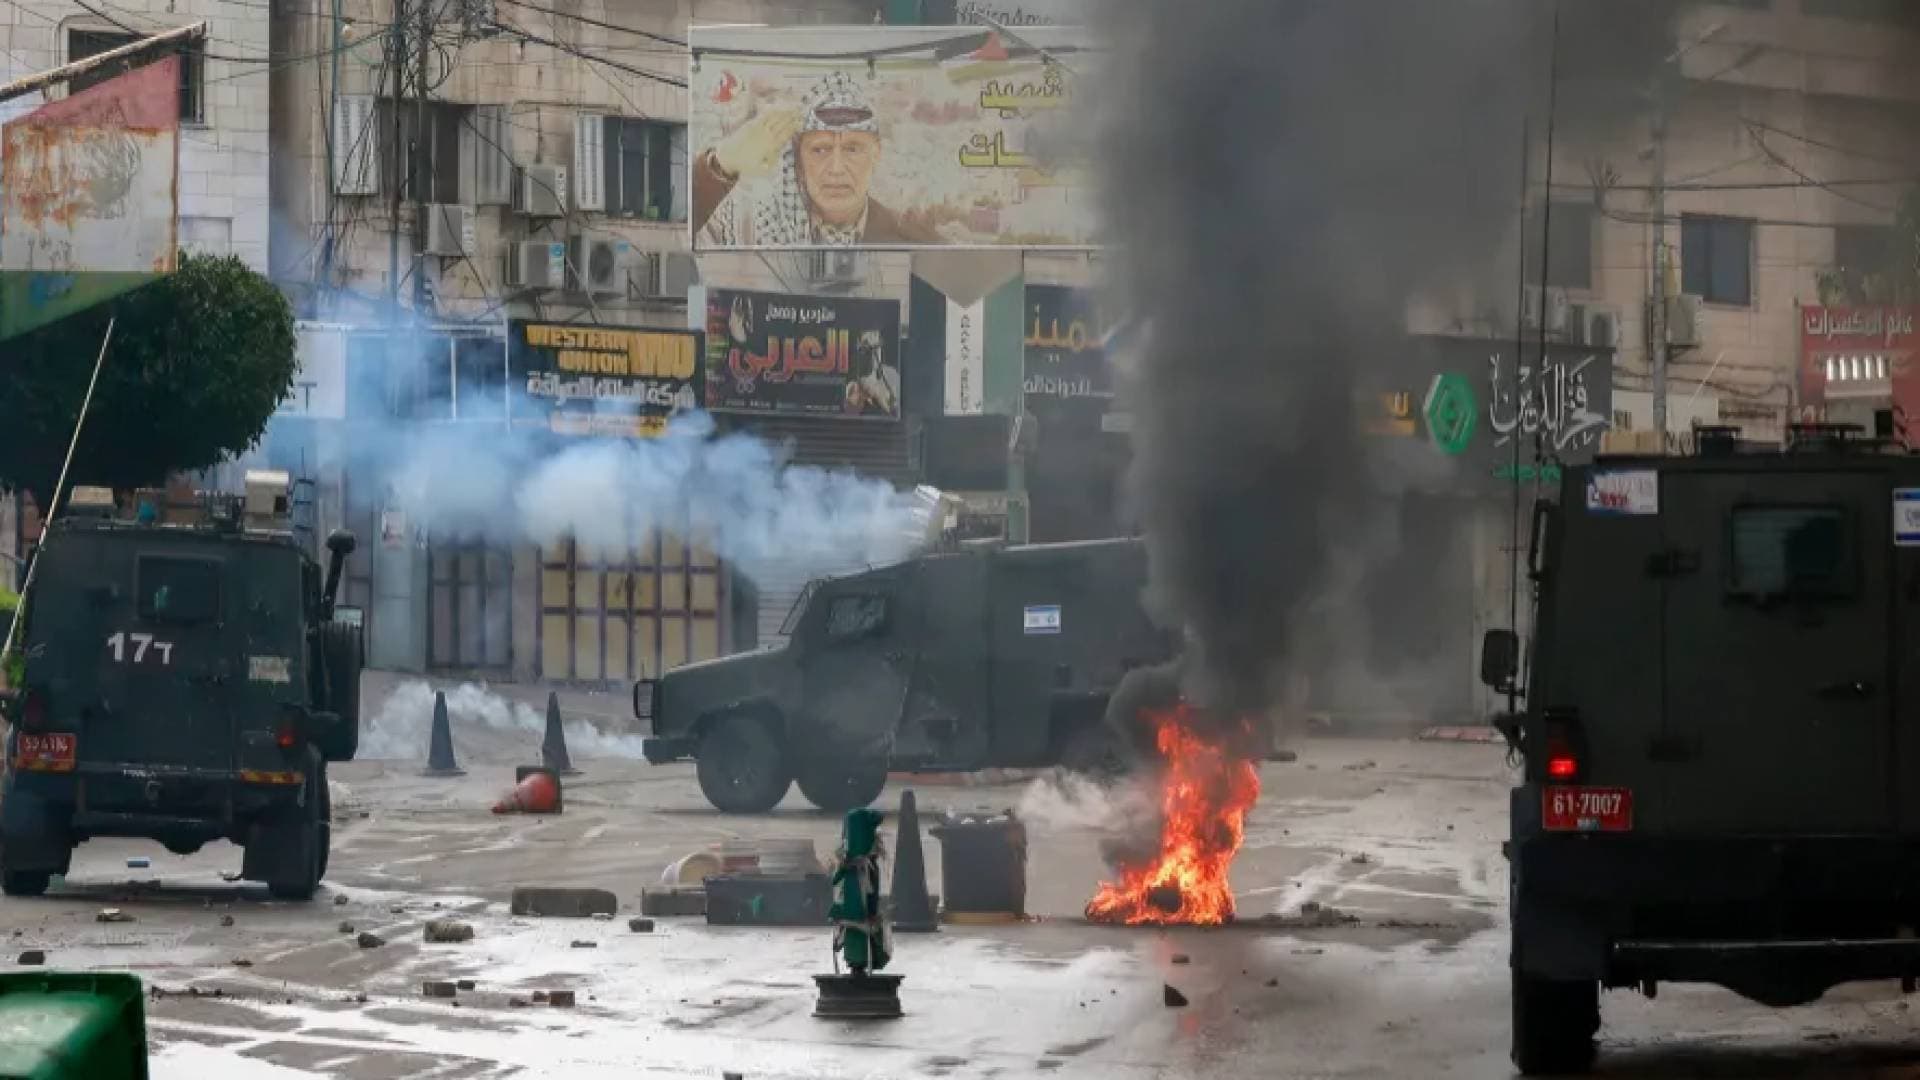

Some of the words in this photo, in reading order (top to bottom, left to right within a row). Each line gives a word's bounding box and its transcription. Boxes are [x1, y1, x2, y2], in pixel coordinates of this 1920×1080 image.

[527, 324, 628, 350] WESTERN
[1806, 308, 1882, 341] المكسرات
[559, 350, 628, 375] UNION
[729, 328, 849, 393] العربي
[1553, 793, 1621, 815] 61-7007
